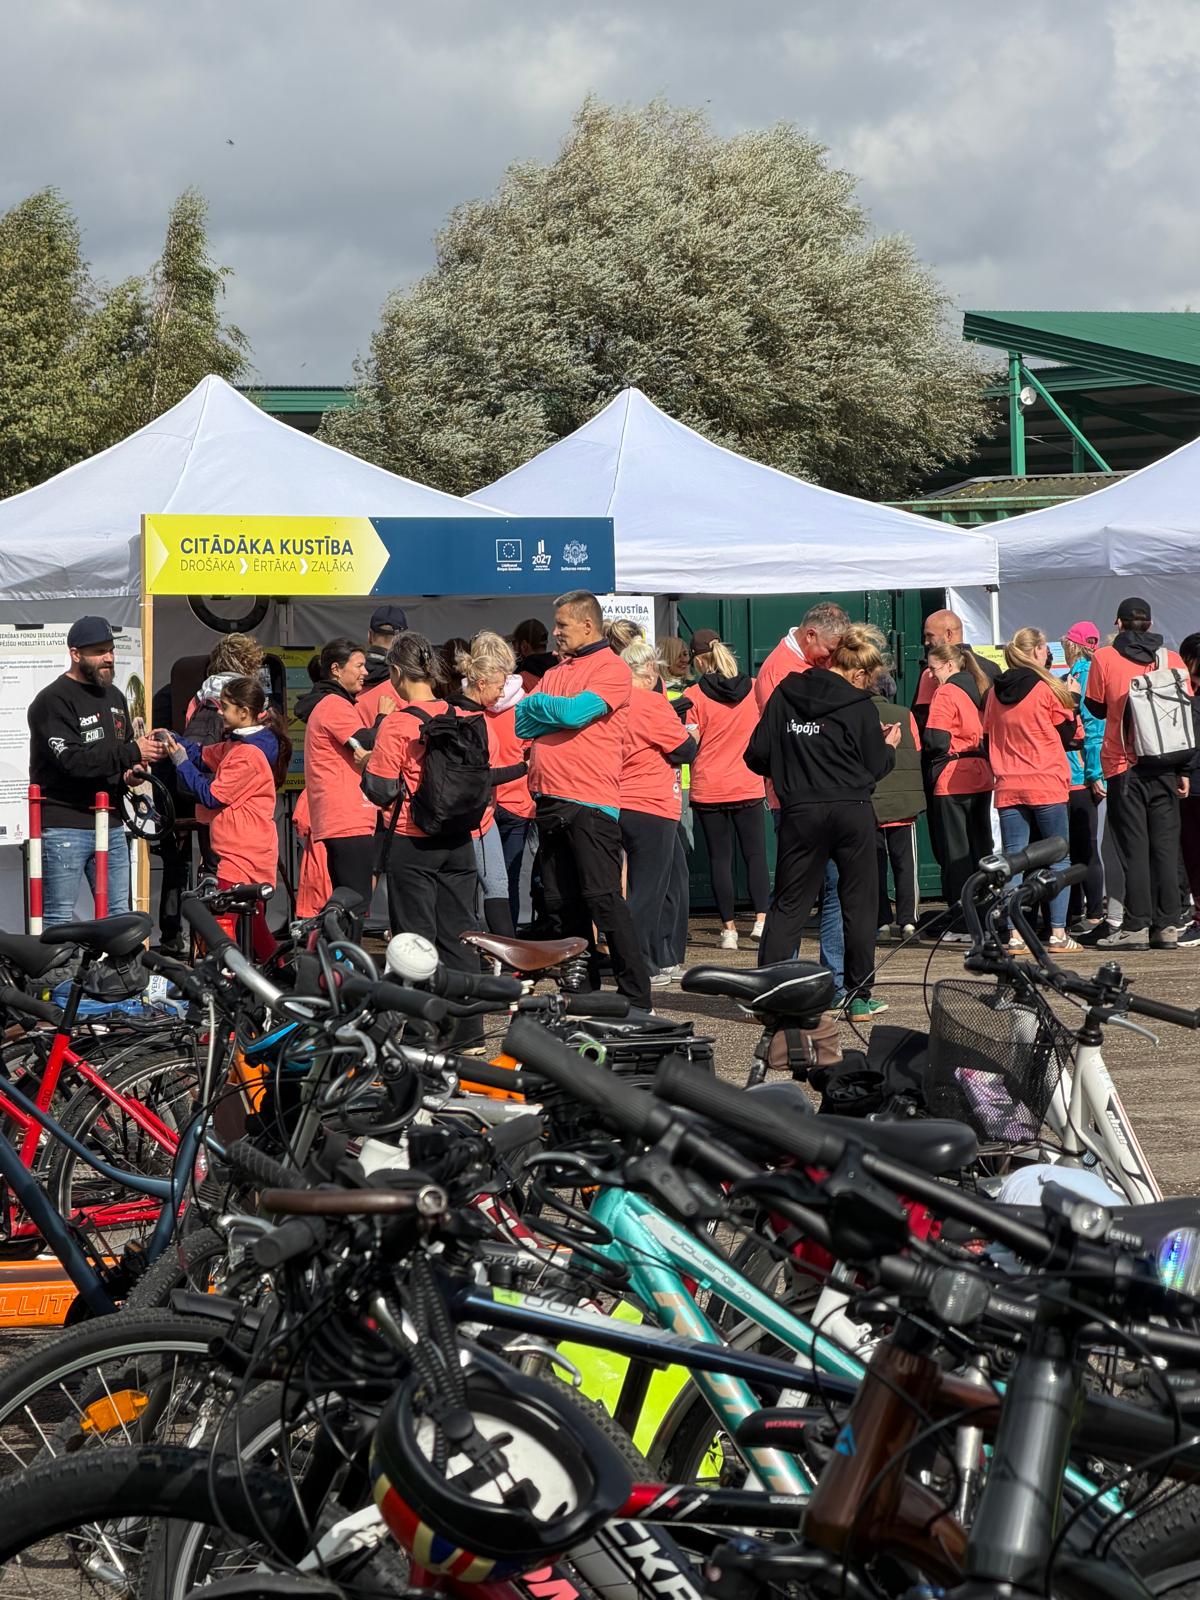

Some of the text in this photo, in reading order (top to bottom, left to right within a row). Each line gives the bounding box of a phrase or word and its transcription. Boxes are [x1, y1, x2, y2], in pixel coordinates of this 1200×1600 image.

[180, 534, 354, 556] CITĀDĀKA KUSTĪBA
[180, 557, 354, 575] DROŠĀKA ĒRTĀKA ZAĻĀKA
[531, 553, 552, 565] 2027
[615, 603, 649, 614] KUSTĪBA
